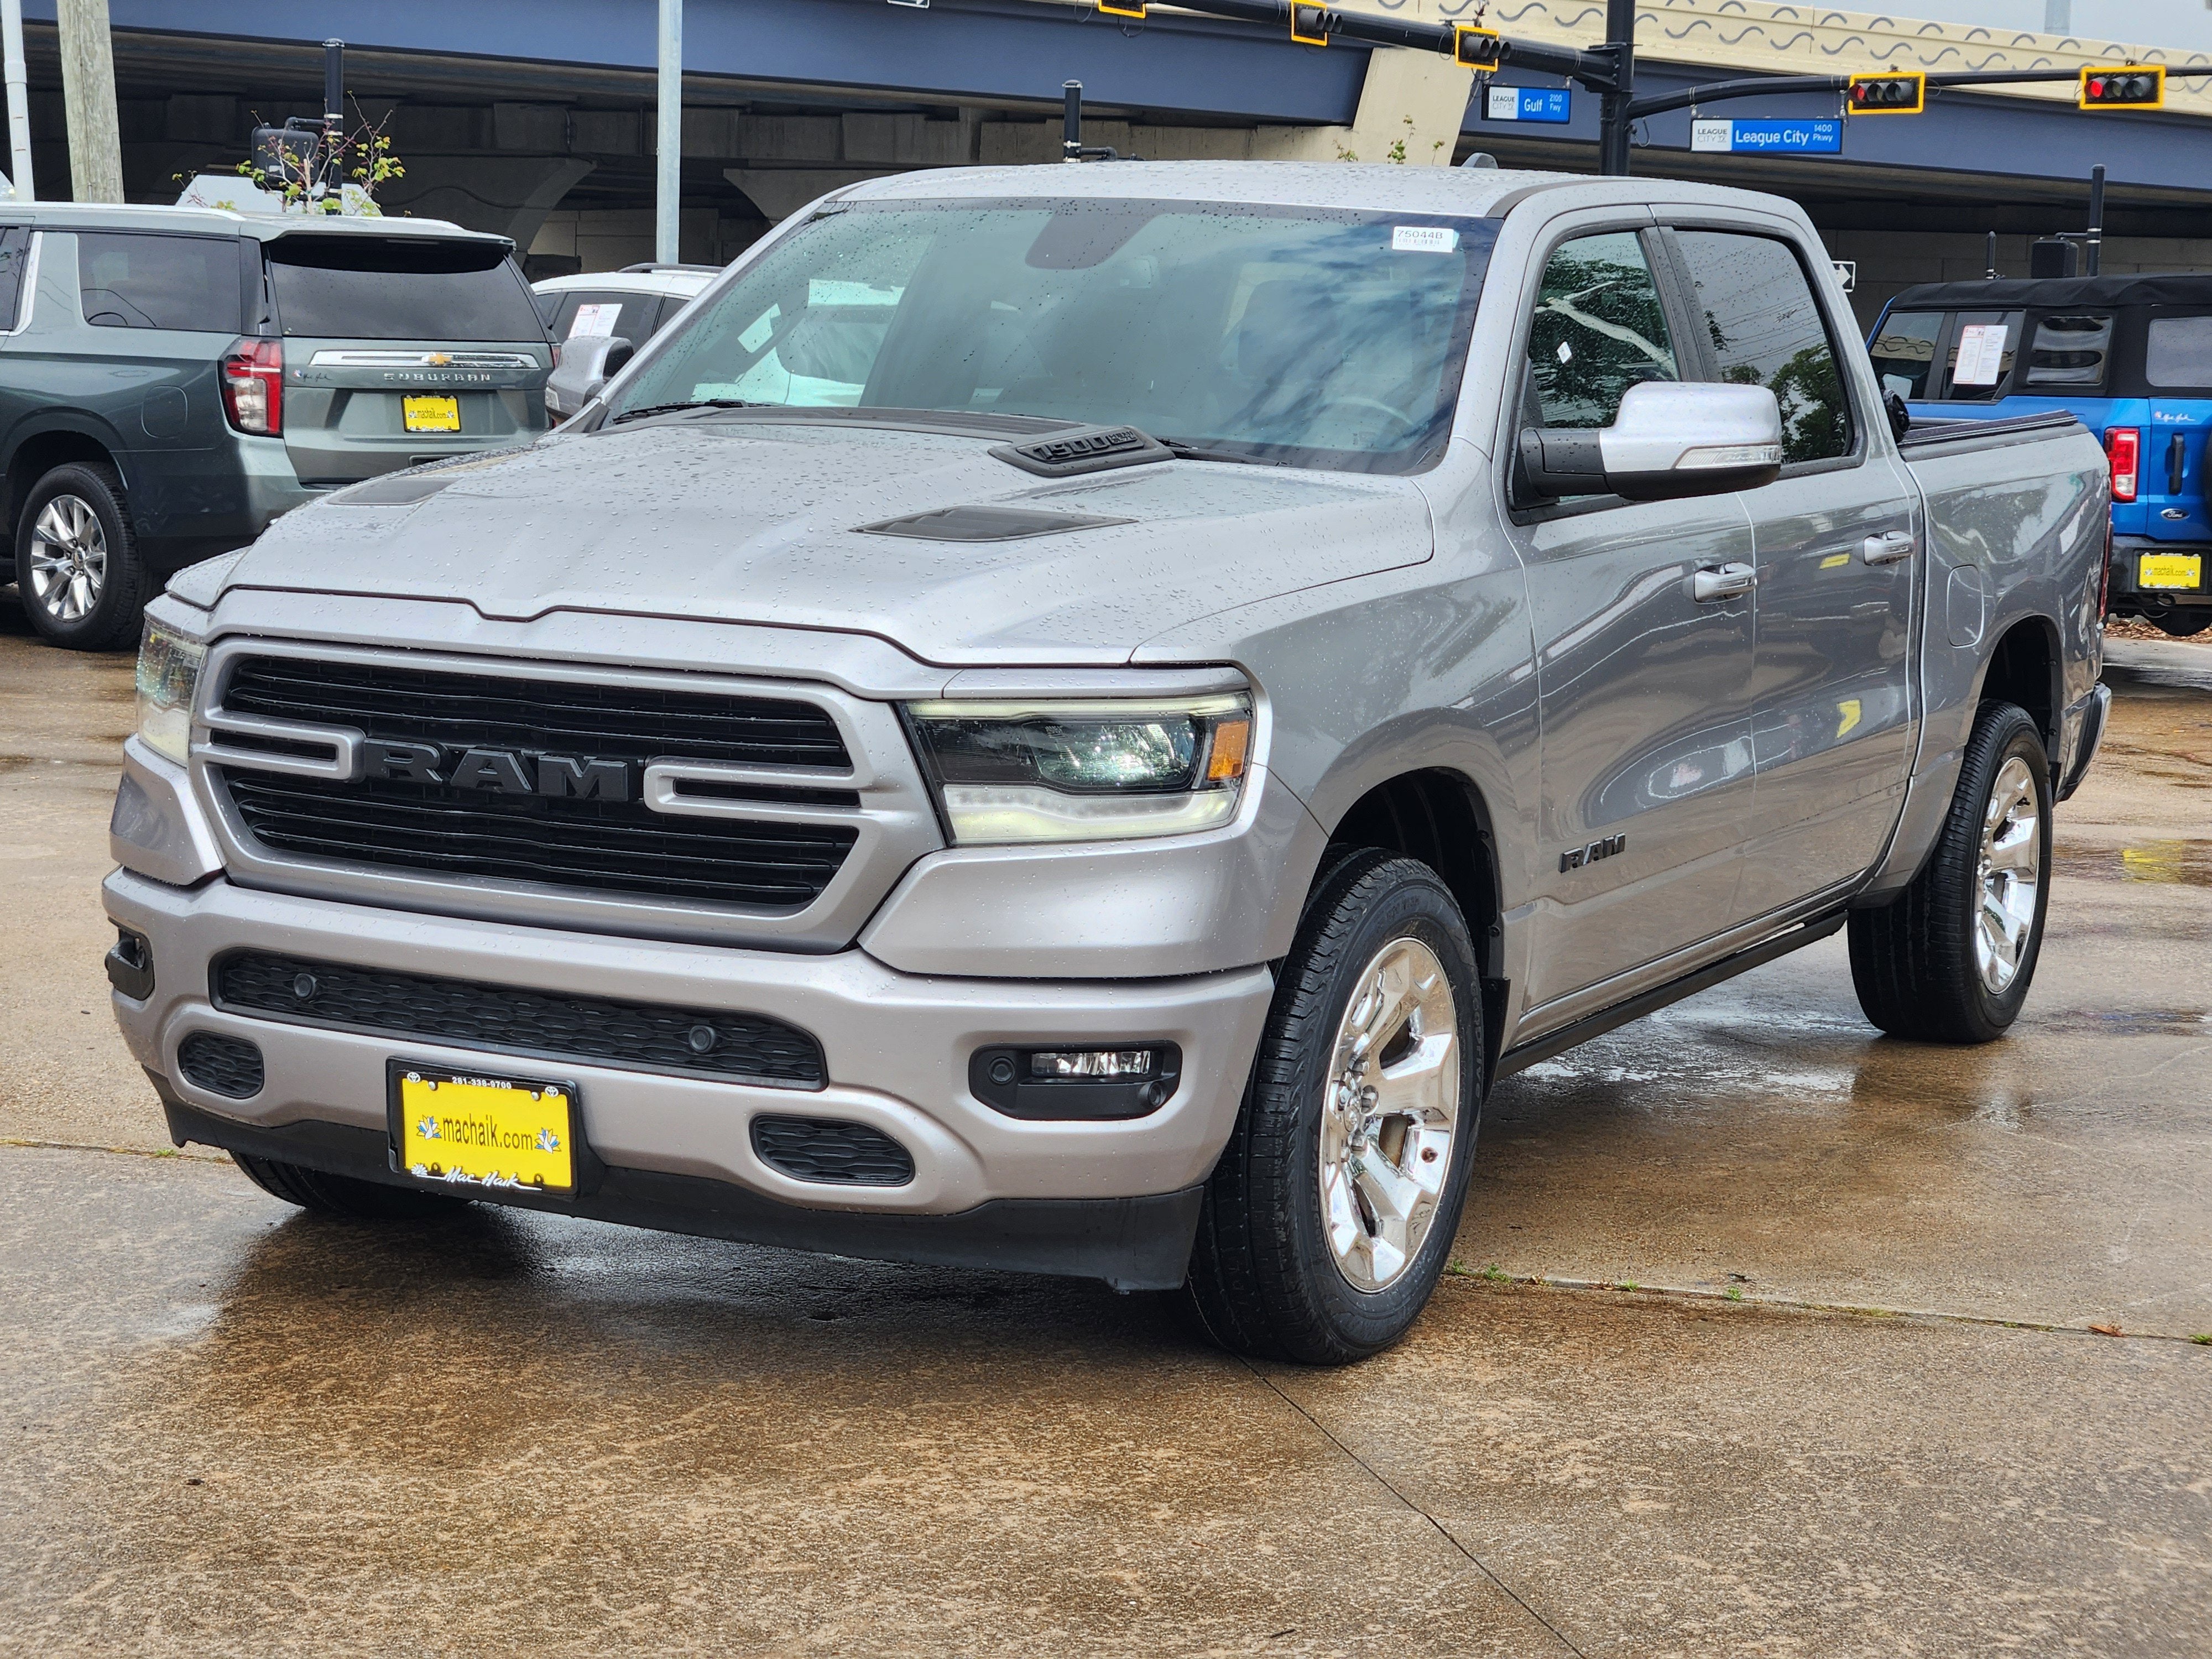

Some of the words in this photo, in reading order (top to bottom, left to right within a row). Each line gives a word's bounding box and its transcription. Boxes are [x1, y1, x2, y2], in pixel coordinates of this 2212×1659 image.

[1549, 93, 1562, 102] 2100
[1524, 98, 1543, 112] Gulf
[1550, 103, 1561, 112] Fwy
[1814, 124, 1832, 132] 1400
[1735, 129, 1781, 147] League
[1783, 129, 1809, 146] City
[1813, 134, 1833, 143] Pkwy
[384, 373, 491, 382] SUBURBAN
[1033, 436, 1110, 460] 1500
[364, 737, 629, 801] RAM
[1558, 832, 1626, 873] RAM
[452, 1076, 512, 1089] 281-338-9700
[442, 1113, 533, 1151] machaik.com
[444, 1165, 476, 1183] Mac
[480, 1170, 520, 1188] Haik
